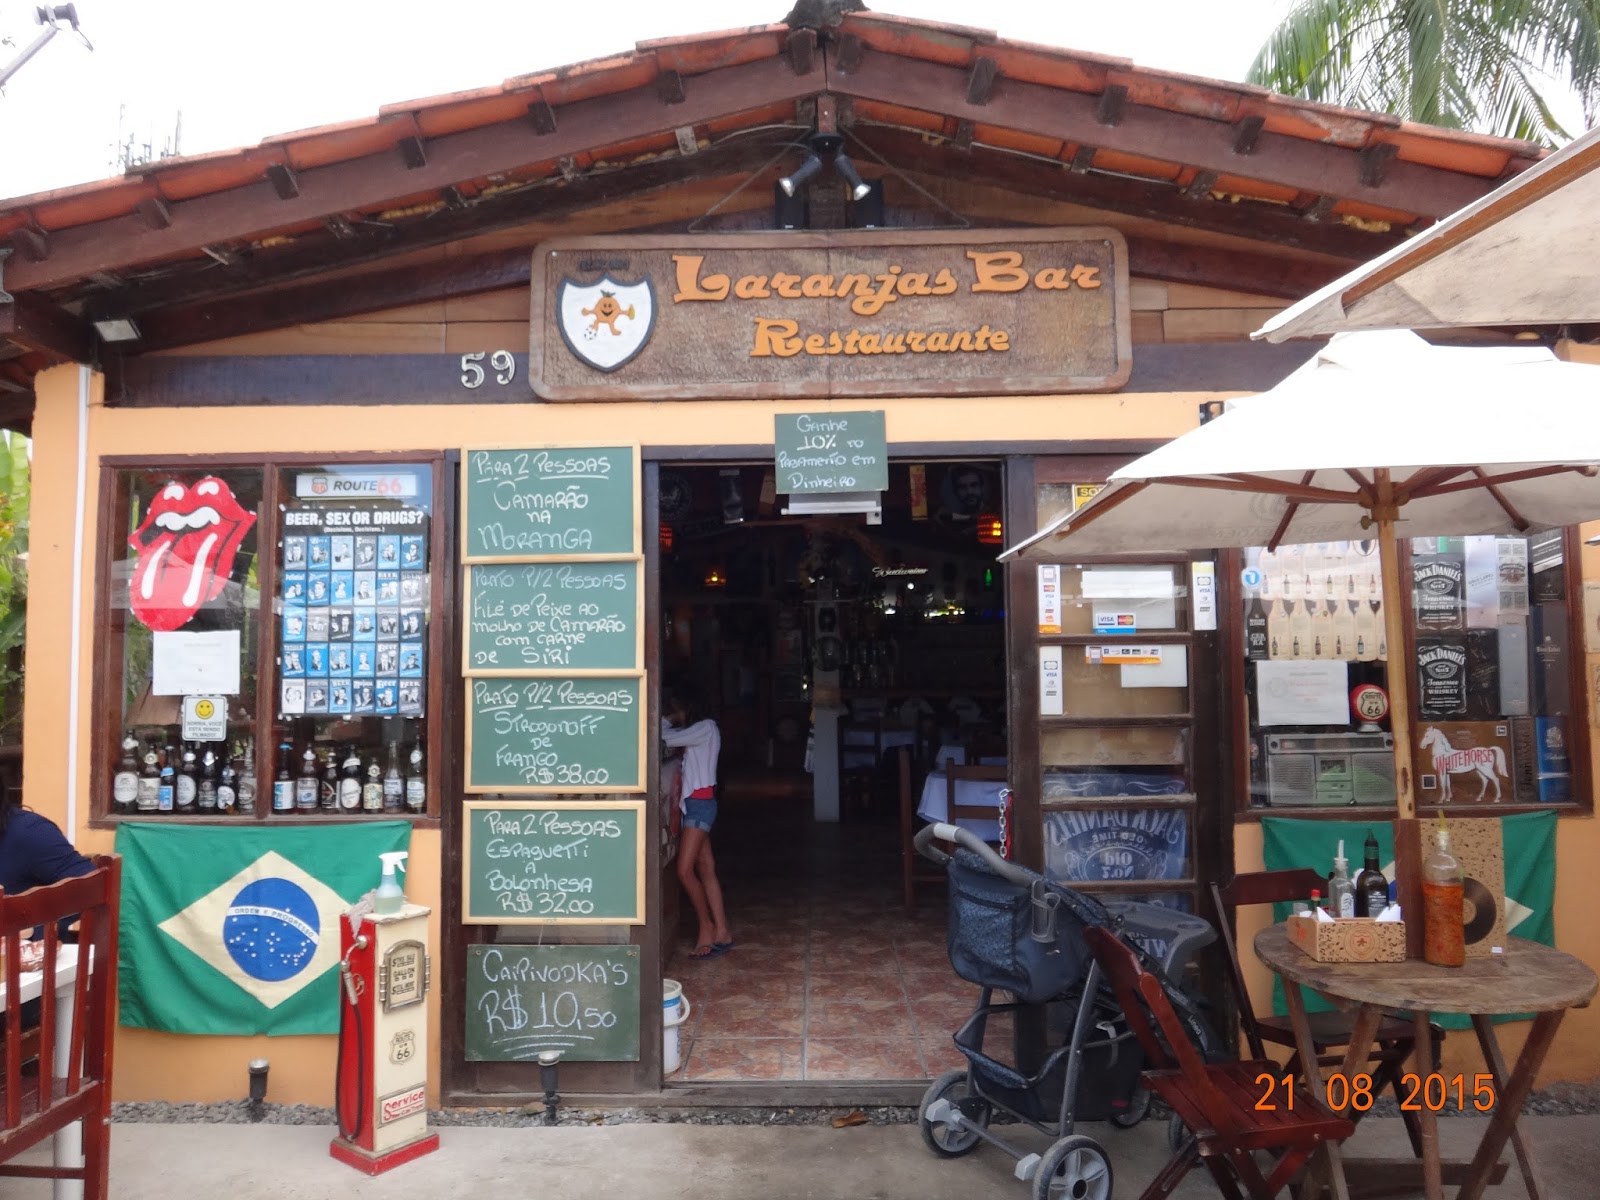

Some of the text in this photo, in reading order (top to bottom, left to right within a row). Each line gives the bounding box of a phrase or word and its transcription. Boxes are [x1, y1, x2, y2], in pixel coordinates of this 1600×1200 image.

[672, 251, 1100, 315] Laranjas Bar
[750, 317, 1010, 358] Restaurante
[460, 350, 516, 389] 59
[796, 434, 836, 450] 10%
[514, 454, 530, 474] 2
[852, 455, 876, 466] em
[1080, 488, 1100, 496] SO
[286, 511, 424, 526] BEER, SEX OR DRUGS?
[1414, 566, 1432, 582] JACK
[1418, 651, 1437, 666] JACK
[1368, 706, 1380, 714] 66
[1435, 750, 1493, 775] WHITE HORSE
[522, 814, 537, 834] 2
[397, 1048, 410, 1059] 66
[384, 1091, 424, 1120] Service
